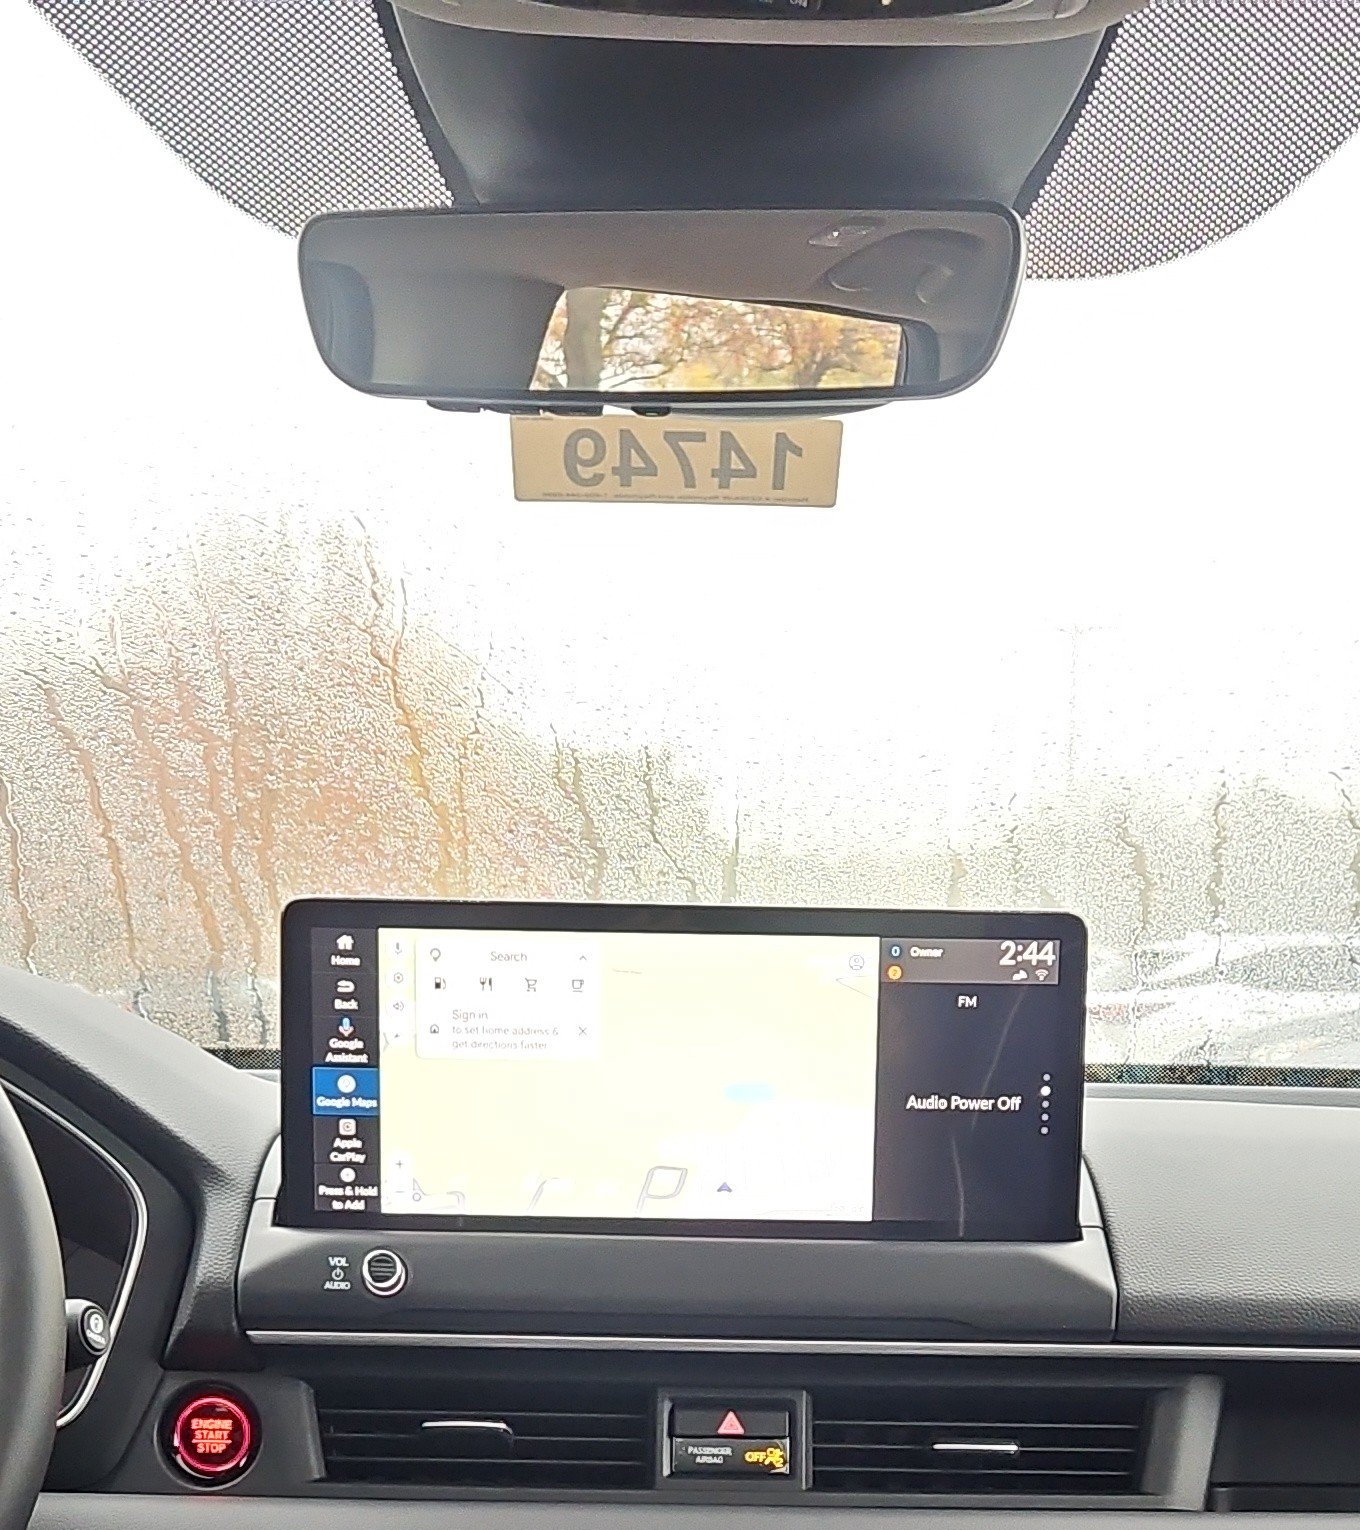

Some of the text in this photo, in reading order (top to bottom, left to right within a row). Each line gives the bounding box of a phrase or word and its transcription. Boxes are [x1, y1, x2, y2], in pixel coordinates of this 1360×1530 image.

[490, 951, 528, 962] Search
[999, 940, 1057, 966] 2:44
[330, 955, 360, 966] Home
[958, 996, 978, 1008] FM
[452, 1010, 489, 1022] Sign in
[465, 1026, 479, 1034] set
[482, 1026, 509, 1035] home
[328, 1038, 364, 1050] Google
[316, 1096, 378, 1109] Google Maps
[906, 1094, 1022, 1111] Audio Power Off
[328, 1256, 349, 1267] VOL
[323, 1281, 351, 1290] AUDIO
[191, 1418, 233, 1430] ENGINE
[194, 1430, 230, 1440] START
[196, 1443, 227, 1454] STOP
[687, 1446, 733, 1456] PASSENGER
[695, 1456, 724, 1464] AIRBAG
[744, 1451, 767, 1463] OFF
